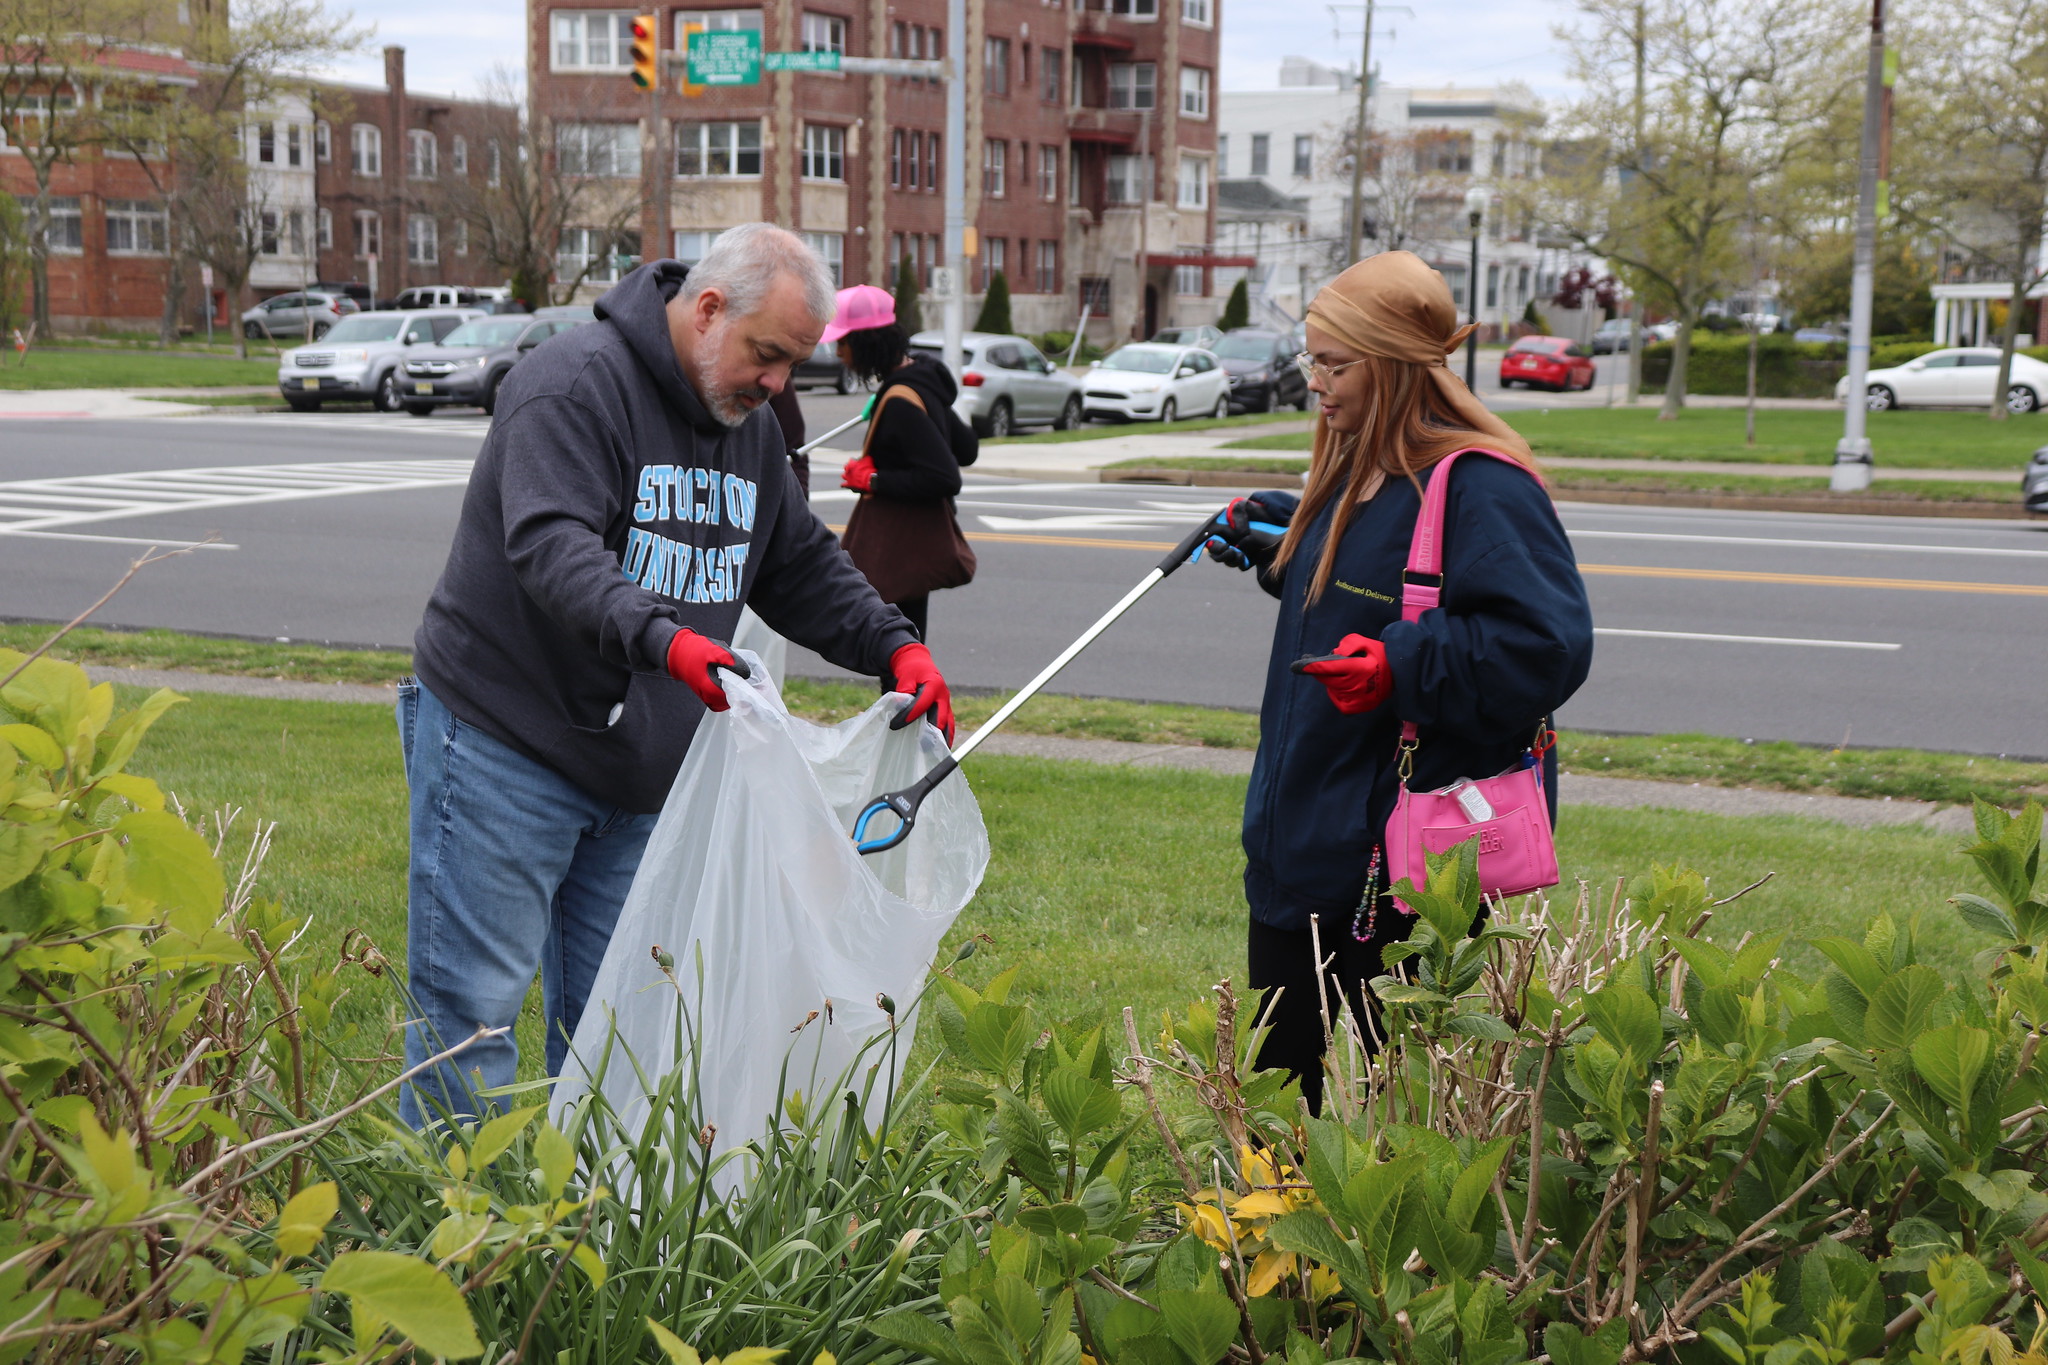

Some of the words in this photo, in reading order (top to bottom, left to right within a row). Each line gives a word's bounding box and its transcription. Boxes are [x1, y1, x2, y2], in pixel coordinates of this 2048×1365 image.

[633, 465, 758, 533] STOCON
[622, 526, 751, 604] UNIVRSIT
[1365, 588, 1396, 604] Delivery
